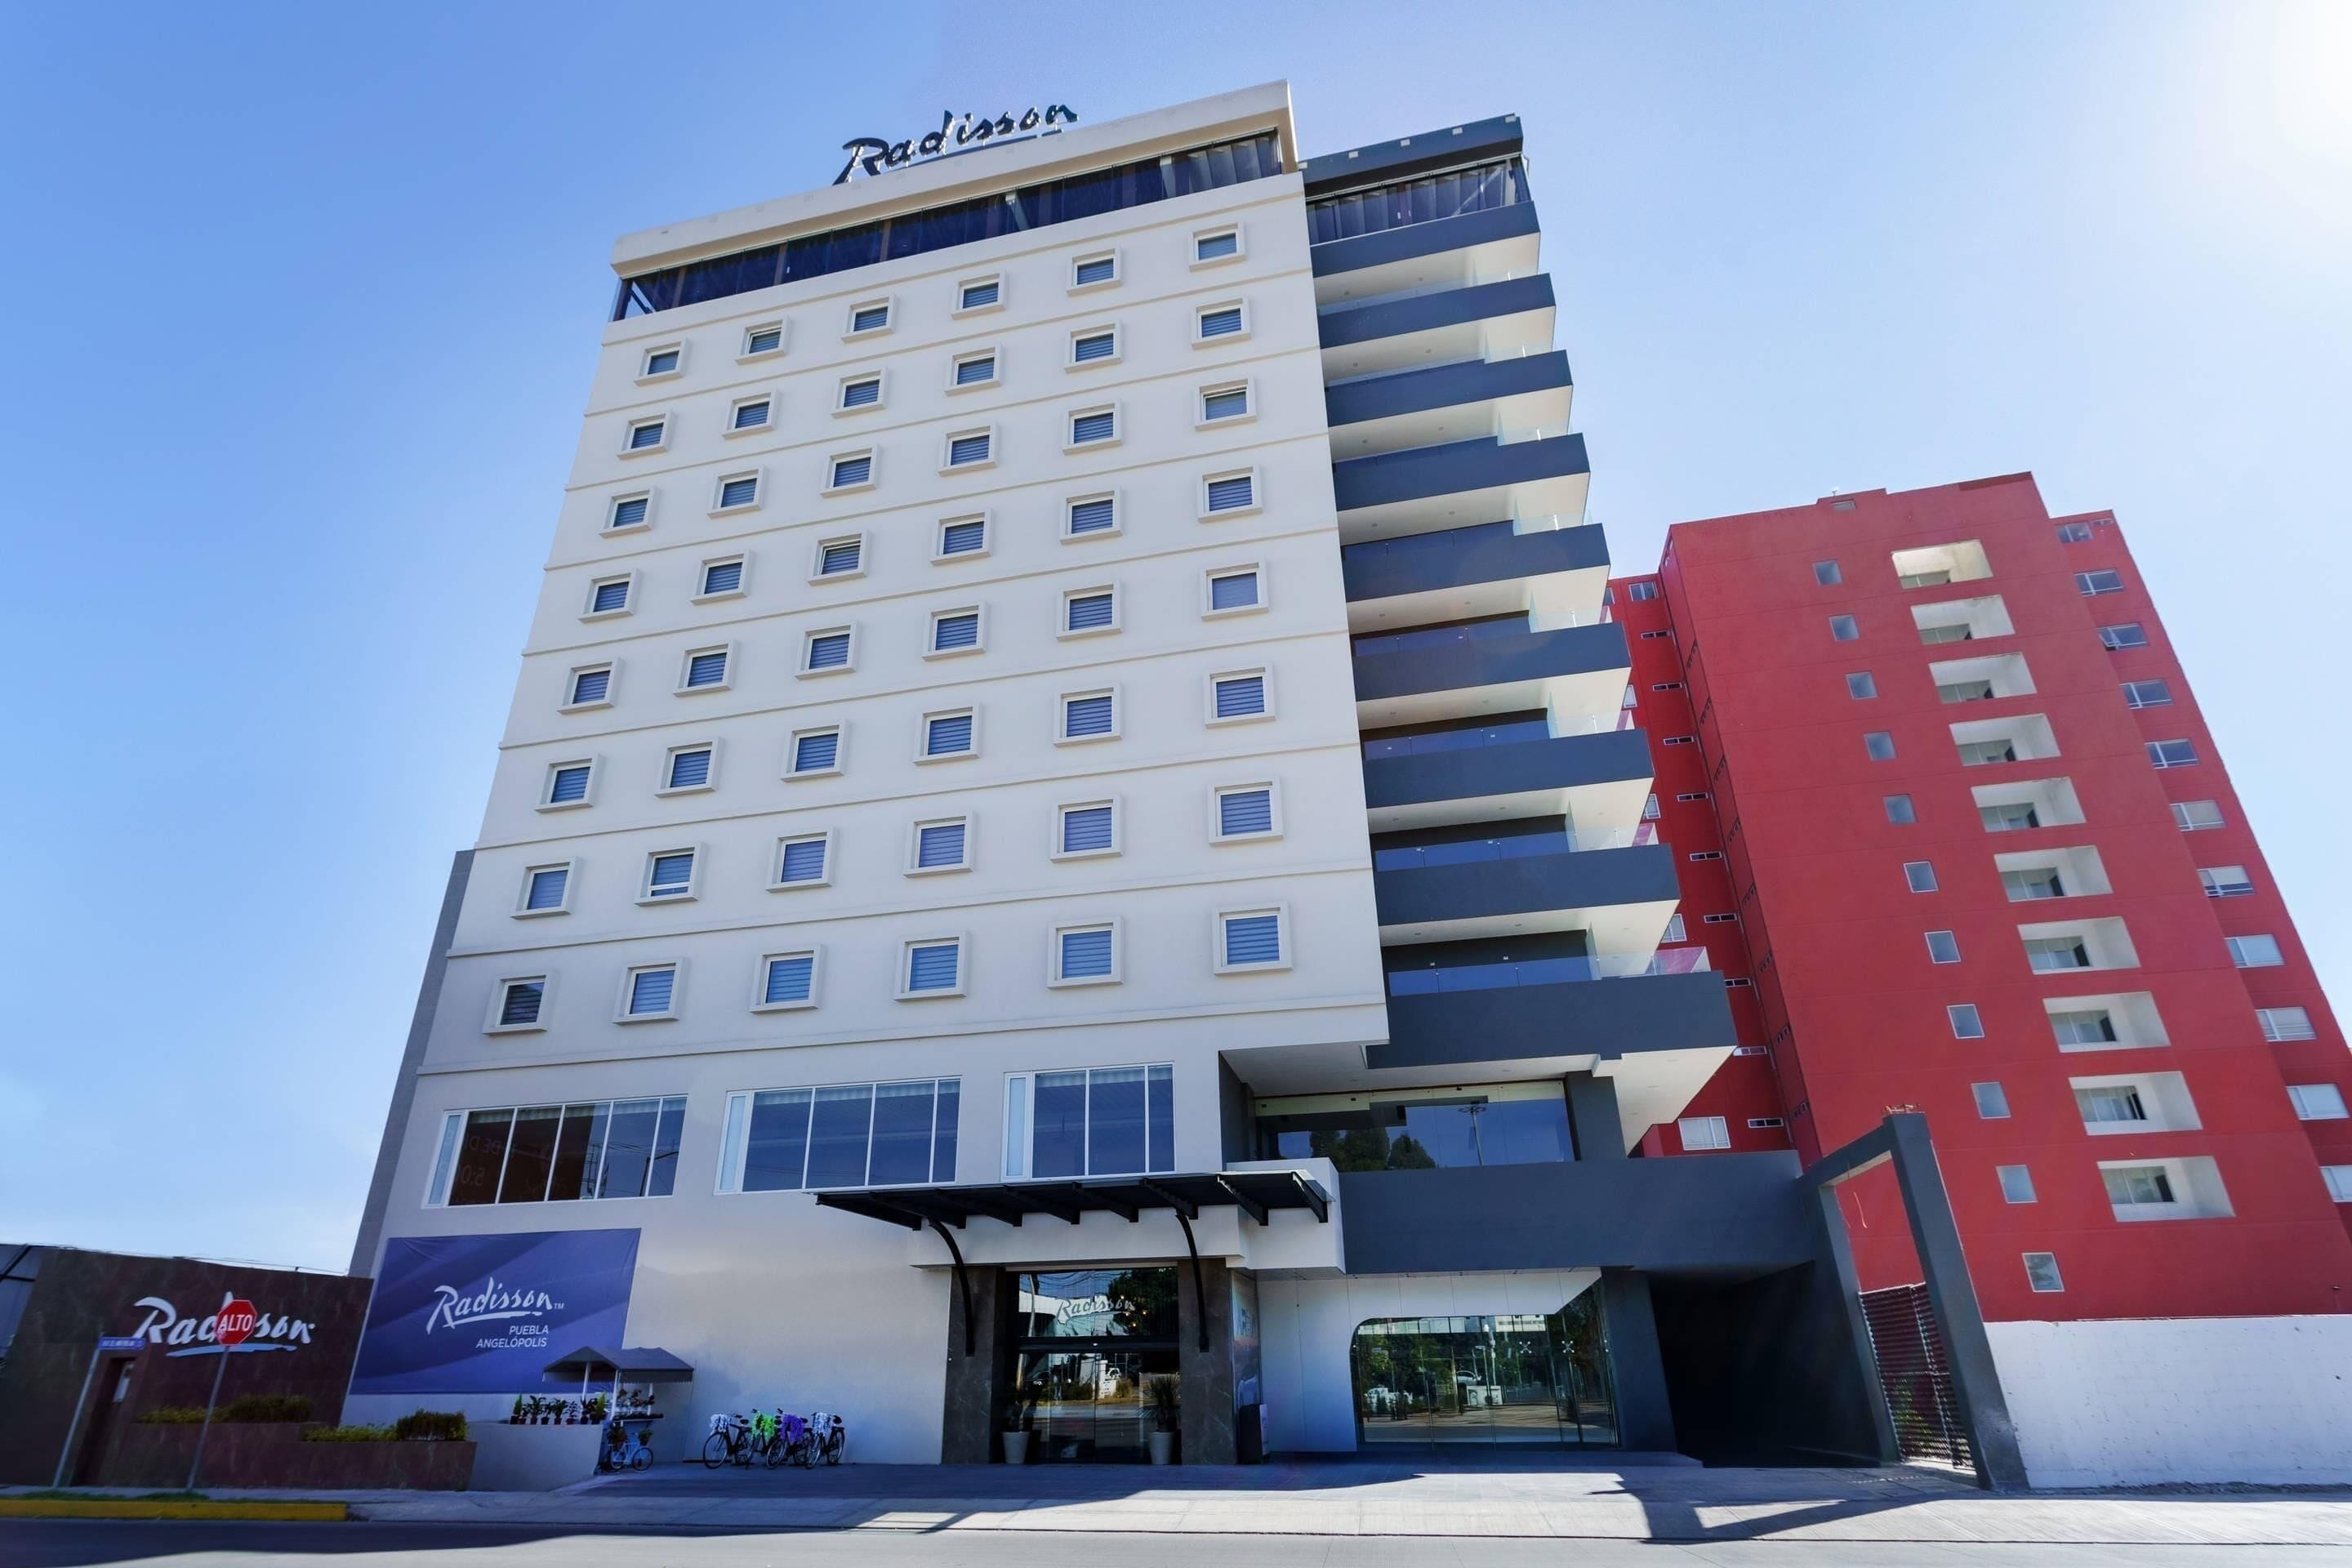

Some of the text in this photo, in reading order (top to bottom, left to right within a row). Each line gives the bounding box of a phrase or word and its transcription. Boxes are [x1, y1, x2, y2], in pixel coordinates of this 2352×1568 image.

[832, 104, 1079, 185] Radisson
[425, 1276, 553, 1334] Radisson
[216, 1314, 253, 1333] ALTO
[510, 1325, 550, 1335] PUEBLA
[476, 1336, 548, 1348] ANGELÓPOLIS
